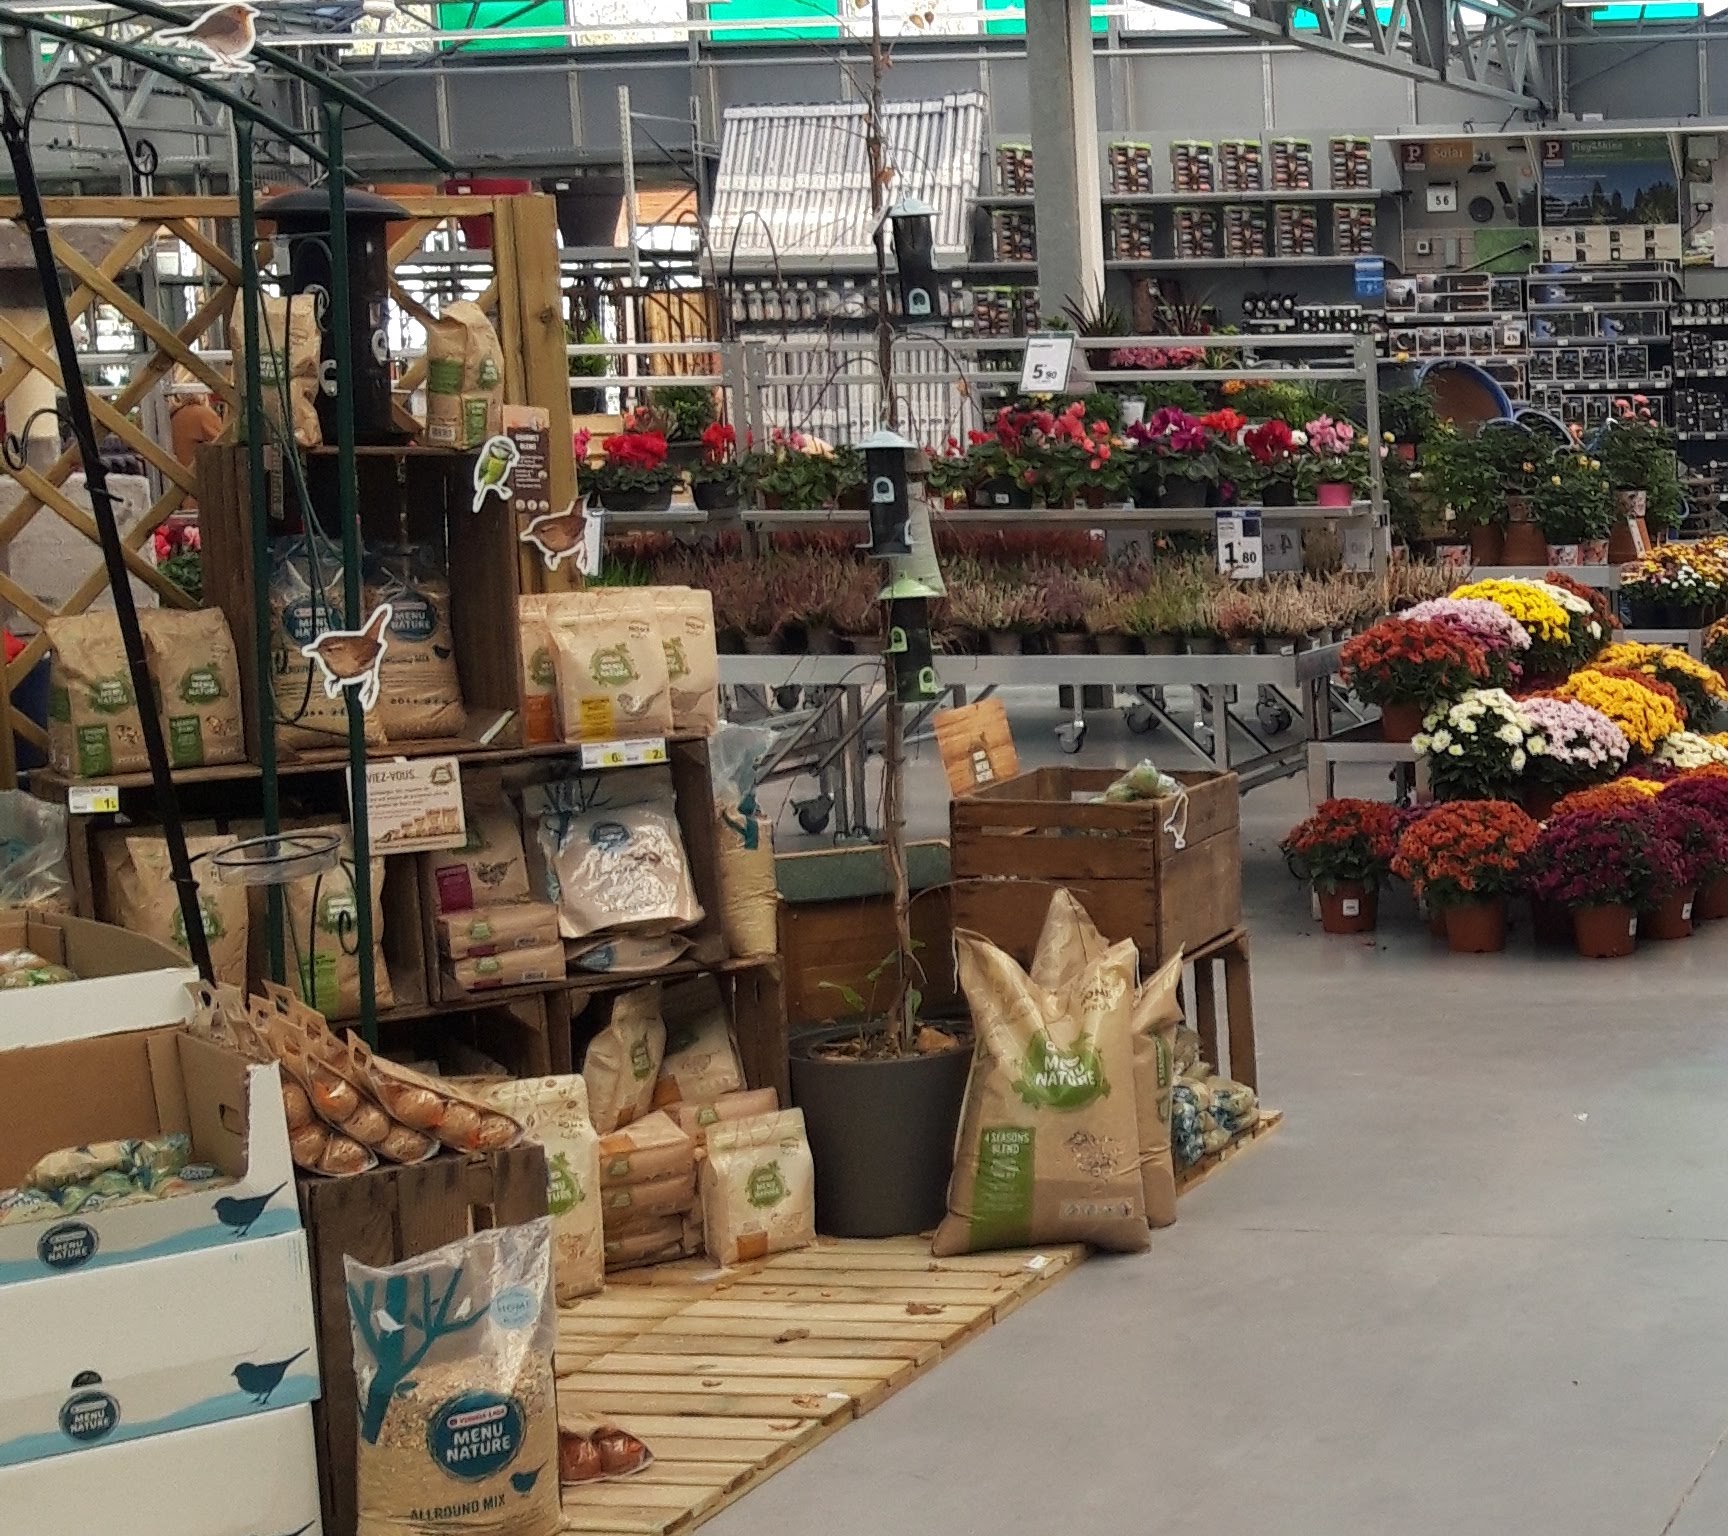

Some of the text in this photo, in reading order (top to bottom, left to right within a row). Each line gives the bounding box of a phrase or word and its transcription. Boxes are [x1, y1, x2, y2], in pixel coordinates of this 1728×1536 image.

[1032, 364, 1044, 379] 5
[1224, 542, 1239, 564] 1
[453, 1421, 504, 1447] MENU
[446, 1434, 512, 1464] NATURE
[410, 1494, 506, 1521] ALLROUND MIX
